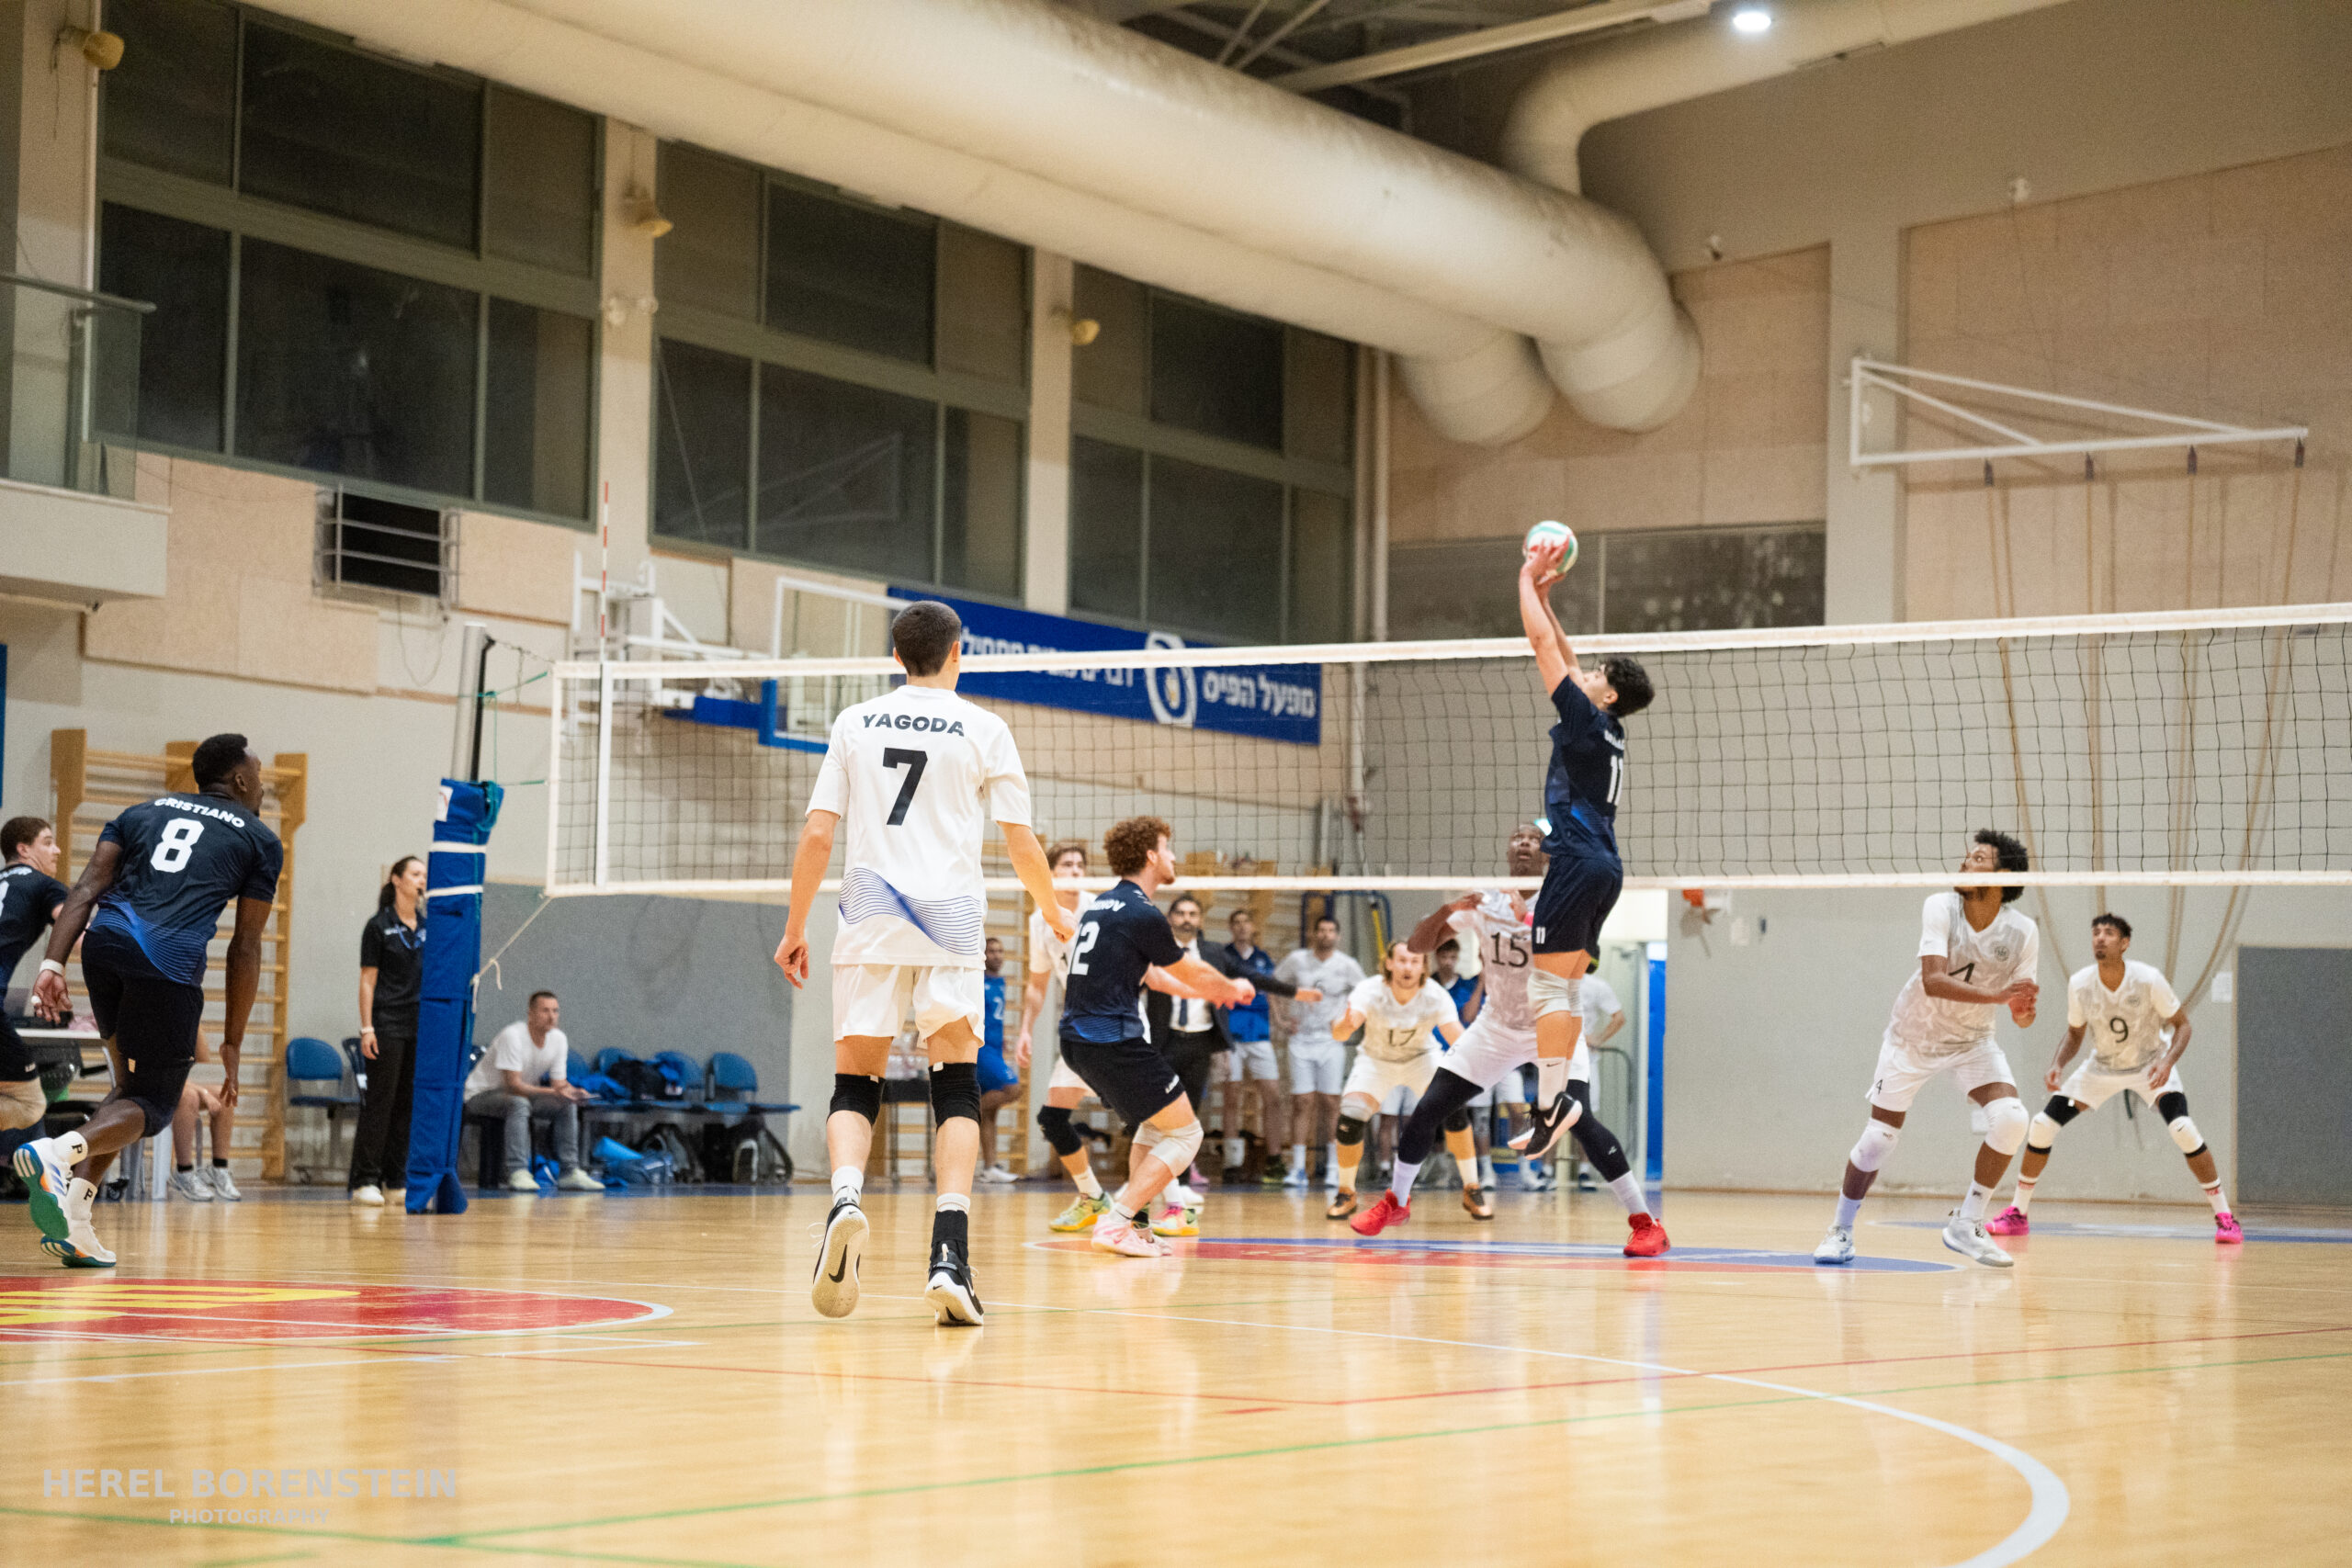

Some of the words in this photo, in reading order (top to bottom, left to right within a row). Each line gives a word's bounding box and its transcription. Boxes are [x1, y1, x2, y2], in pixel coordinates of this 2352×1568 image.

[1203, 670, 1256, 708] הפיס
[1258, 673, 1317, 718] מפעל
[863, 713, 965, 737] YAGODA
[883, 747, 928, 826] 7
[154, 797, 245, 828] CRISTIANO
[150, 818, 205, 874] 8
[1070, 921, 1101, 976] 2
[1490, 931, 1529, 968] 15
[1536, 926, 1546, 944] 11
[1387, 1029, 1417, 1047] 17
[2109, 1017, 2129, 1043] 9
[1875, 1078, 1883, 1095] 4
